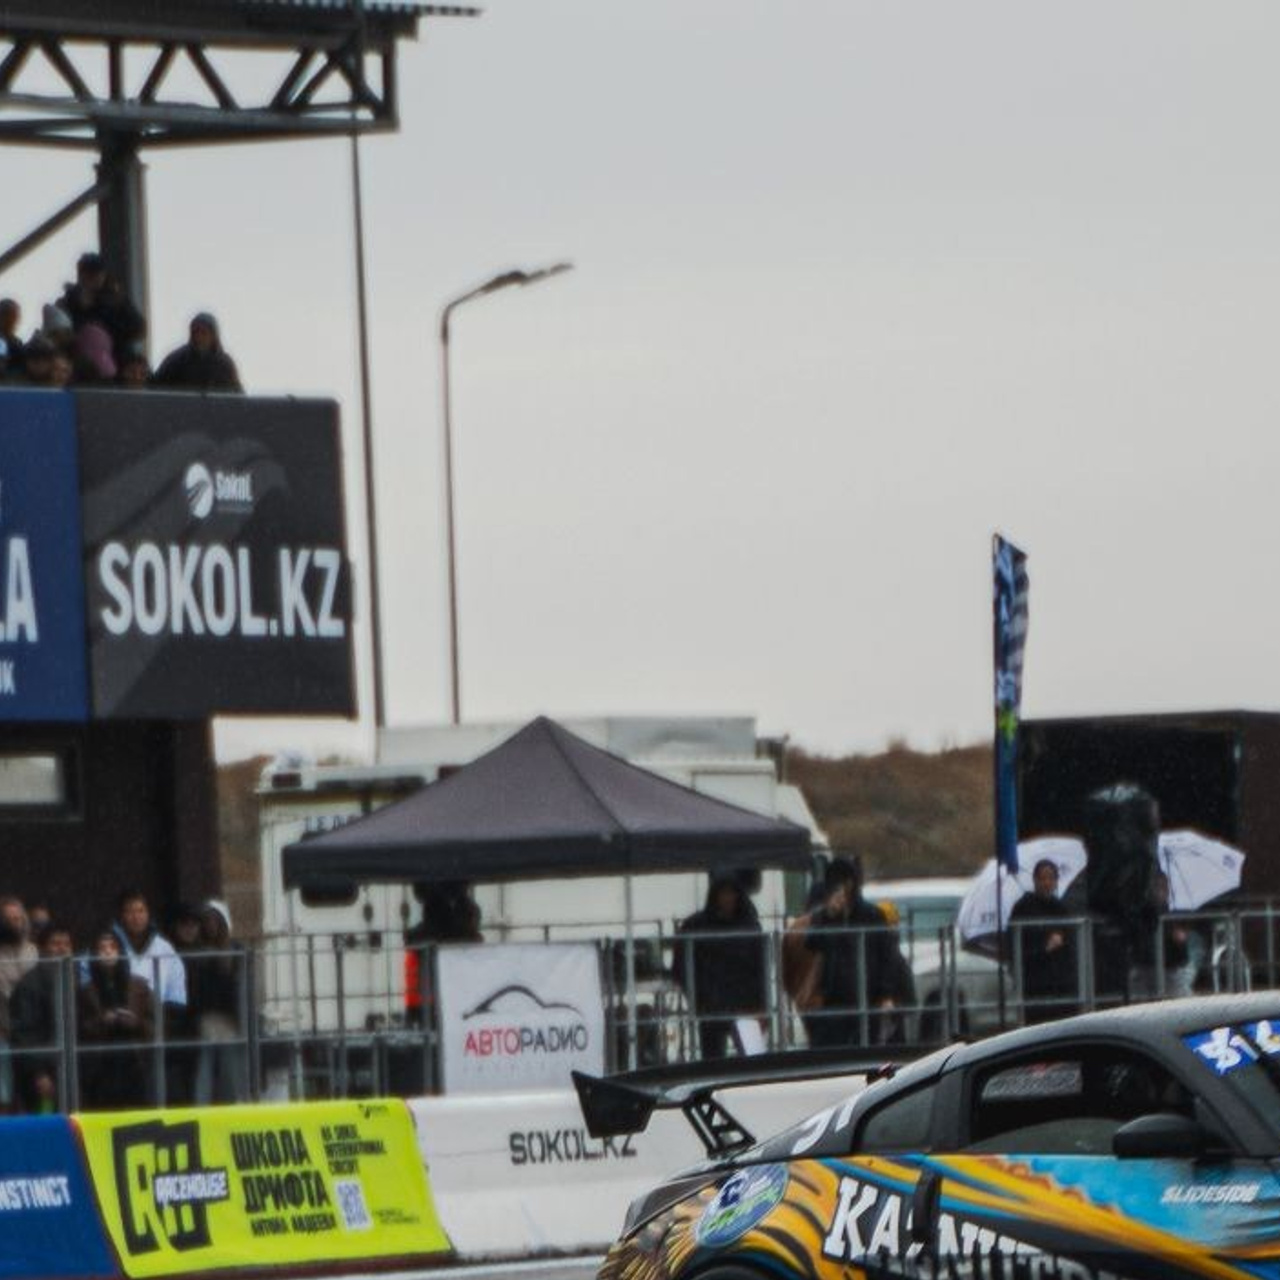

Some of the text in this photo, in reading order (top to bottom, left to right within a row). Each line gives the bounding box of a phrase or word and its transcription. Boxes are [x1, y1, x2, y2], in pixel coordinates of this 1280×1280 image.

[99, 542, 344, 637] SOKOL.KZ
[230, 1128, 312, 1172] ШКОЛА
[242, 1170, 332, 1214] ДРИФТА
